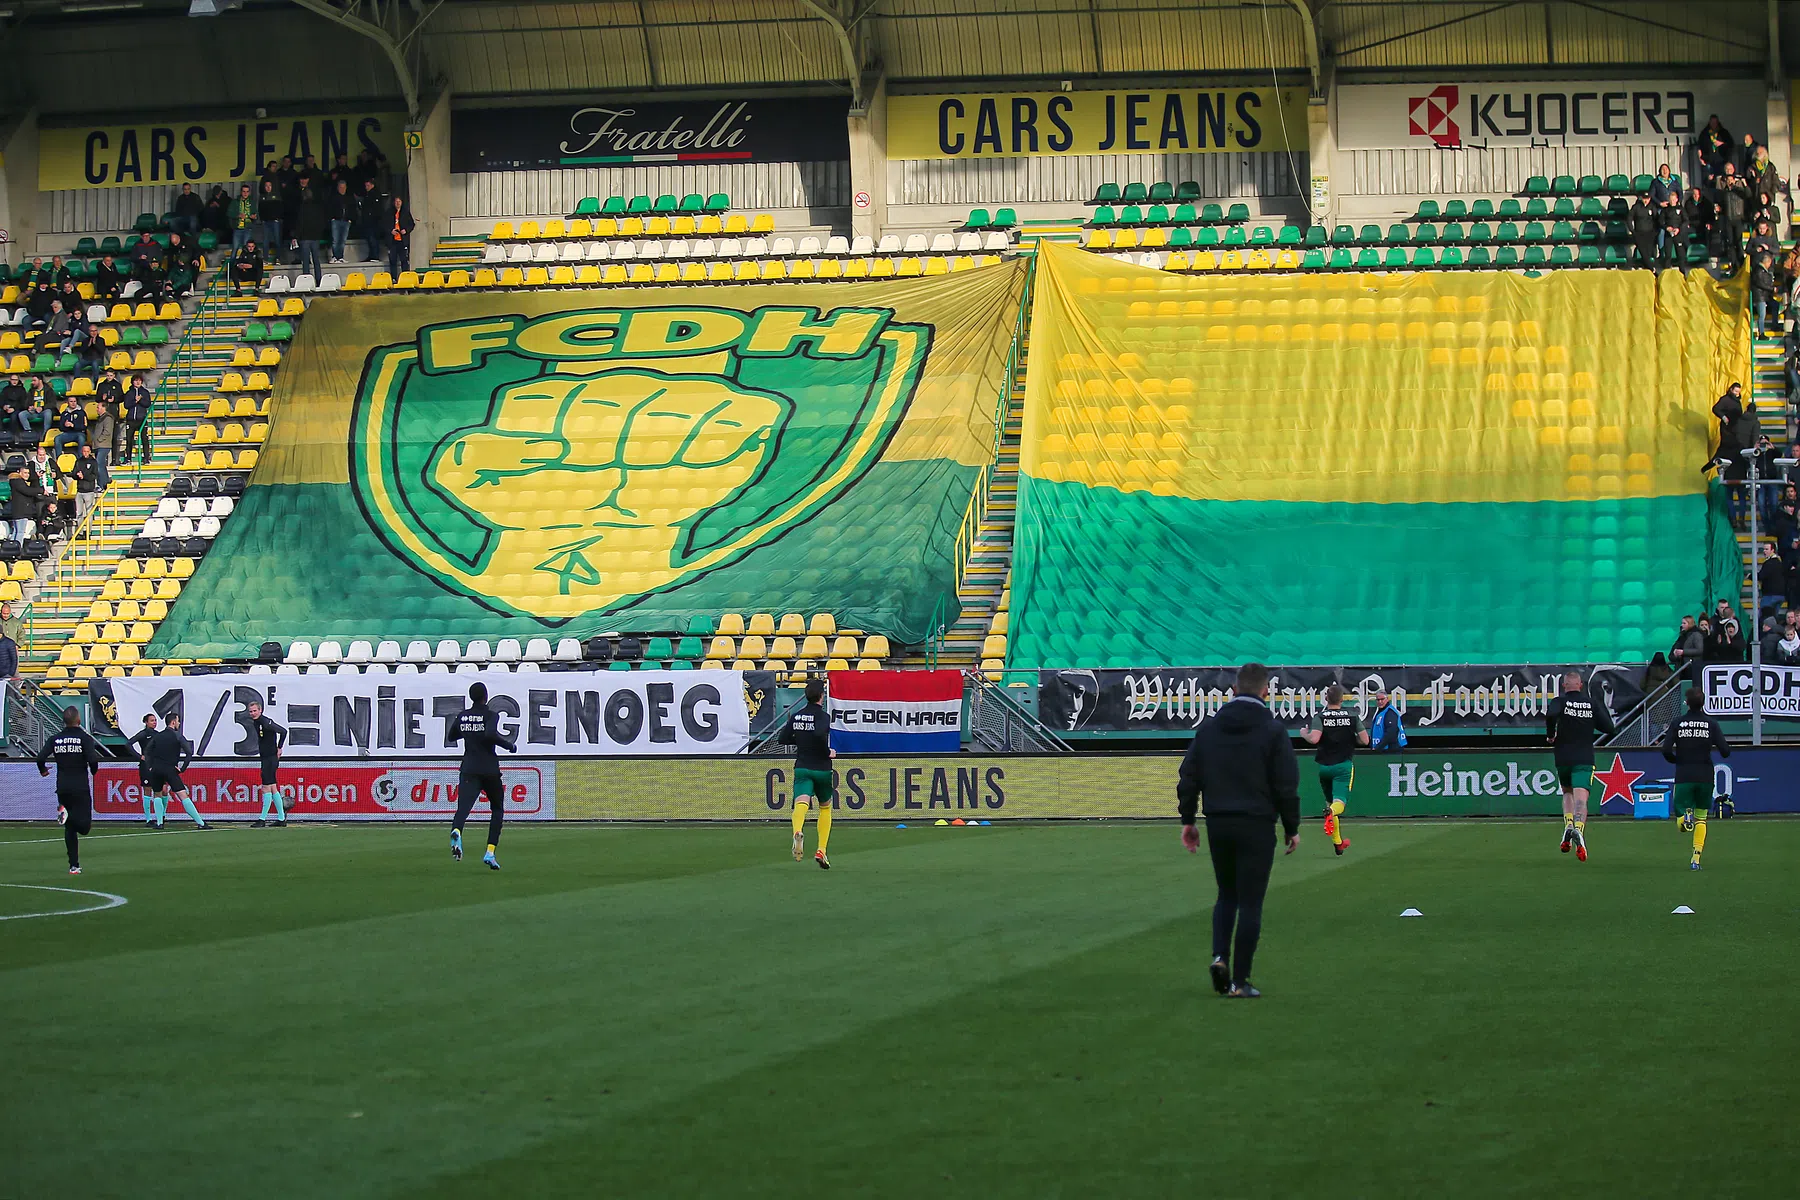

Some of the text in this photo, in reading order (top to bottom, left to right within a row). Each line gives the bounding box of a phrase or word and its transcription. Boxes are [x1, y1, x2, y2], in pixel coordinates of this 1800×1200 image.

[559, 101, 752, 154] Fratelli
[938, 91, 1262, 155] CARS JEANS
[1470, 91, 1696, 137] KYOCERA
[84, 117, 383, 185] CARS JEANS
[424, 308, 888, 371] FCDH
[486, 682, 722, 746] GENOEG
[831, 709, 959, 727] FC DEN HAAG
[1418, 672, 1563, 727] Football
[1677, 729, 1710, 739] CARS JEANS
[883, 767, 1005, 810] JEANS
[1387, 761, 1564, 797] Heineke
